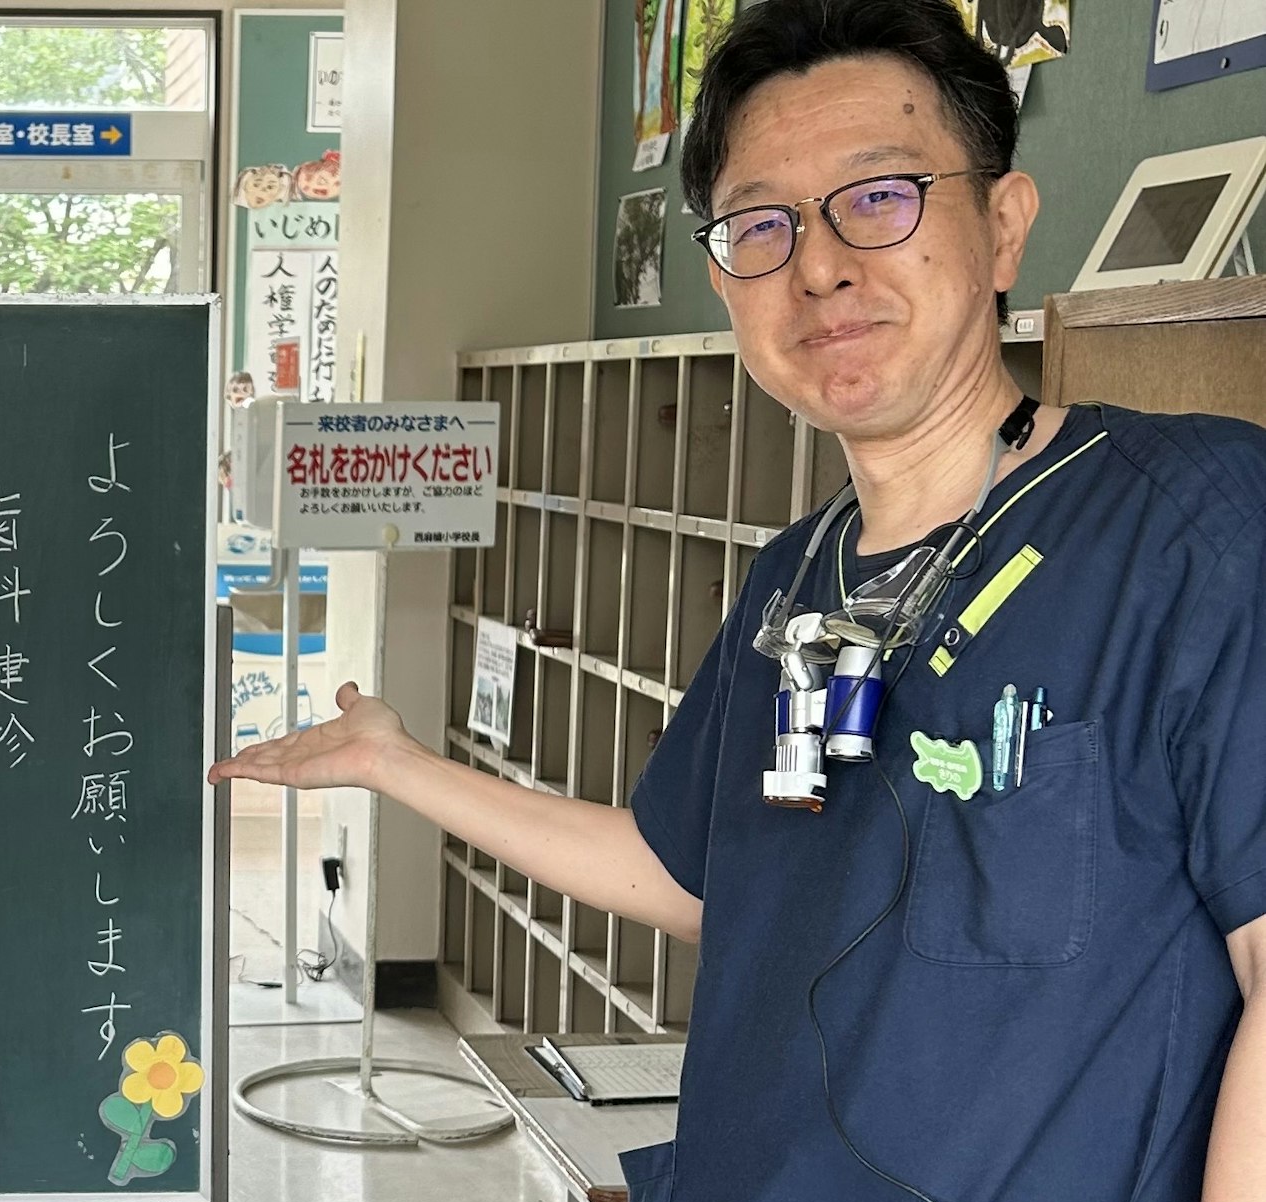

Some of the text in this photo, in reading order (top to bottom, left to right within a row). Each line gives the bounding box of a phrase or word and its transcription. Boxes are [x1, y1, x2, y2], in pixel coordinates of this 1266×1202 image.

[318, 415, 465, 432] 来校者のみなさまへ
[287, 443, 492, 484] 名札をおかけください
[71, 433, 133, 1060] よろしくお願いします
